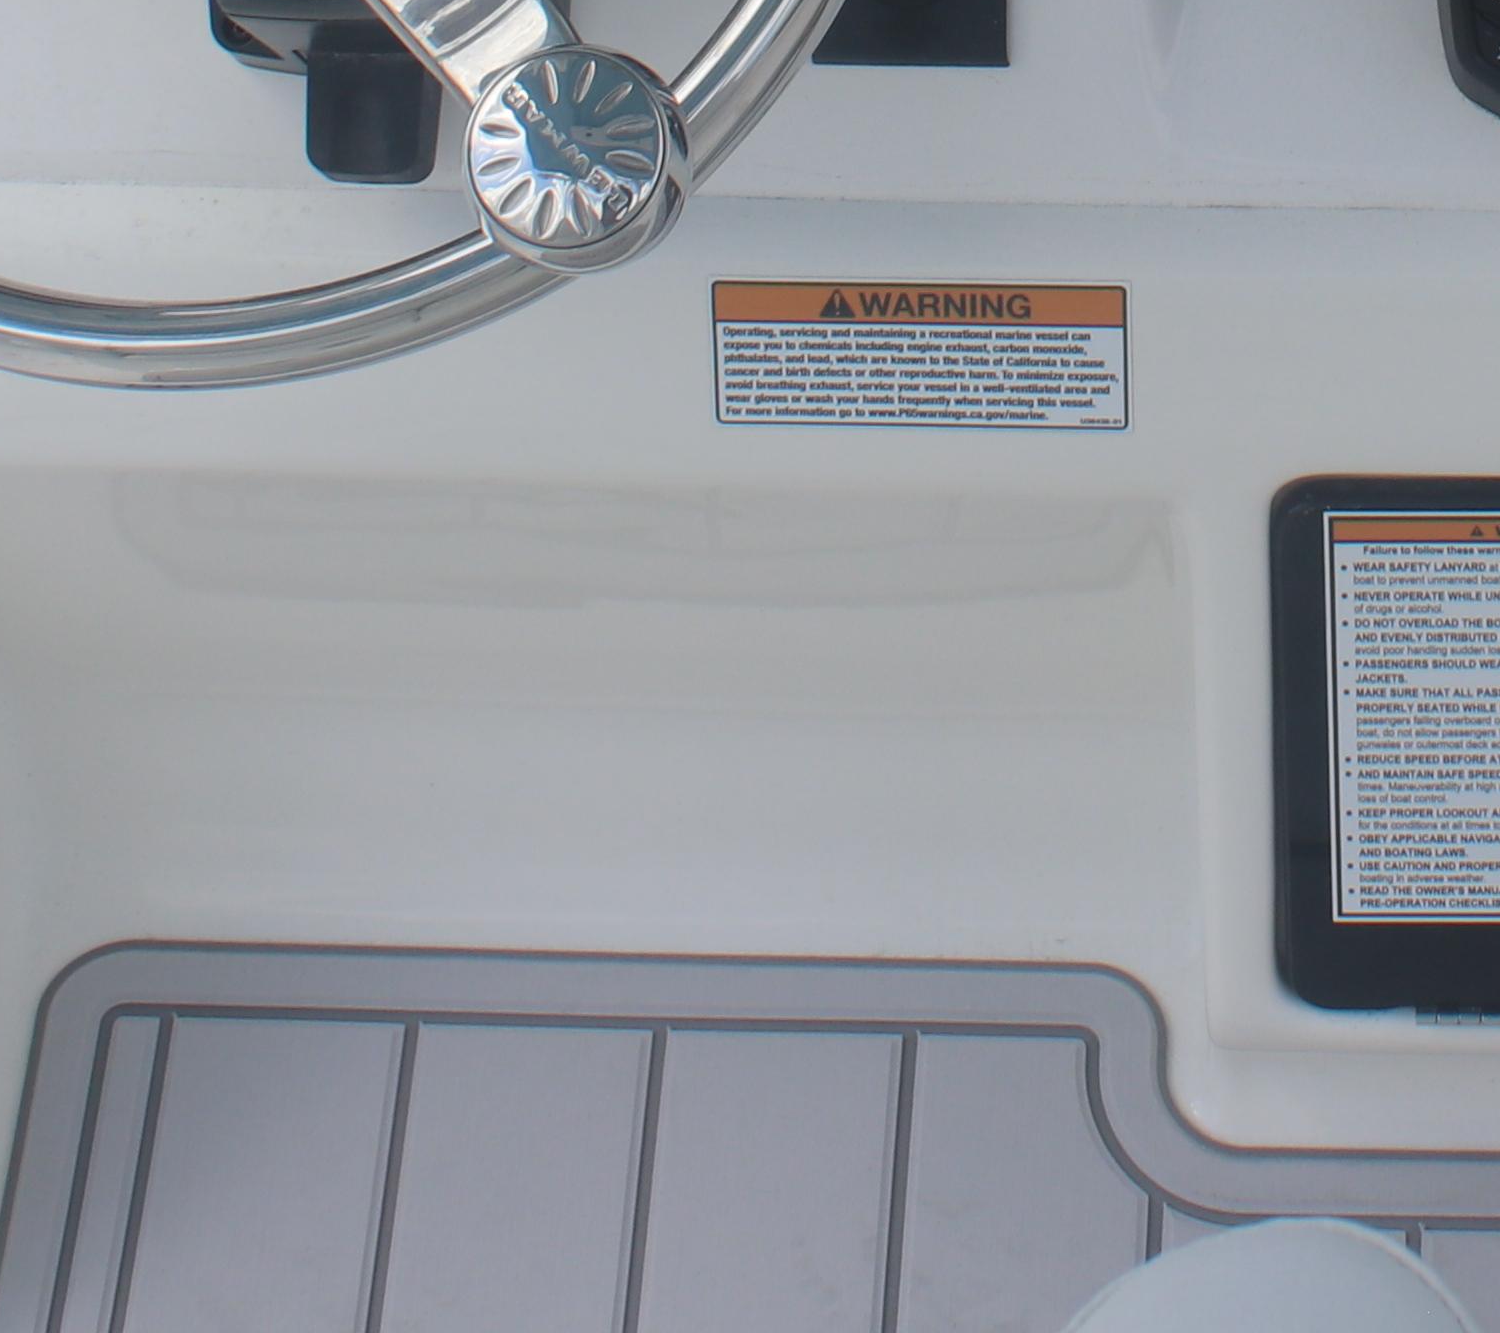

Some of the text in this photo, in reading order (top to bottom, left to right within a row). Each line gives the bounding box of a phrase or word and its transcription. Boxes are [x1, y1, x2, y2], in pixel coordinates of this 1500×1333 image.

[503, 80, 635, 221] LEWMAR
[858, 292, 1031, 319] WARNING
[722, 326, 1090, 341] Operating, servicing and maintaining a recreational marine vessel can
[725, 406, 741, 415] For
[745, 408, 772, 416] more
[775, 406, 836, 416] information
[838, 409, 852, 418] go
[855, 407, 865, 417] to
[1354, 591, 1390, 601] NEVER
[1393, 591, 1444, 601] OPERATE
[1447, 591, 1481, 601] WHILE
